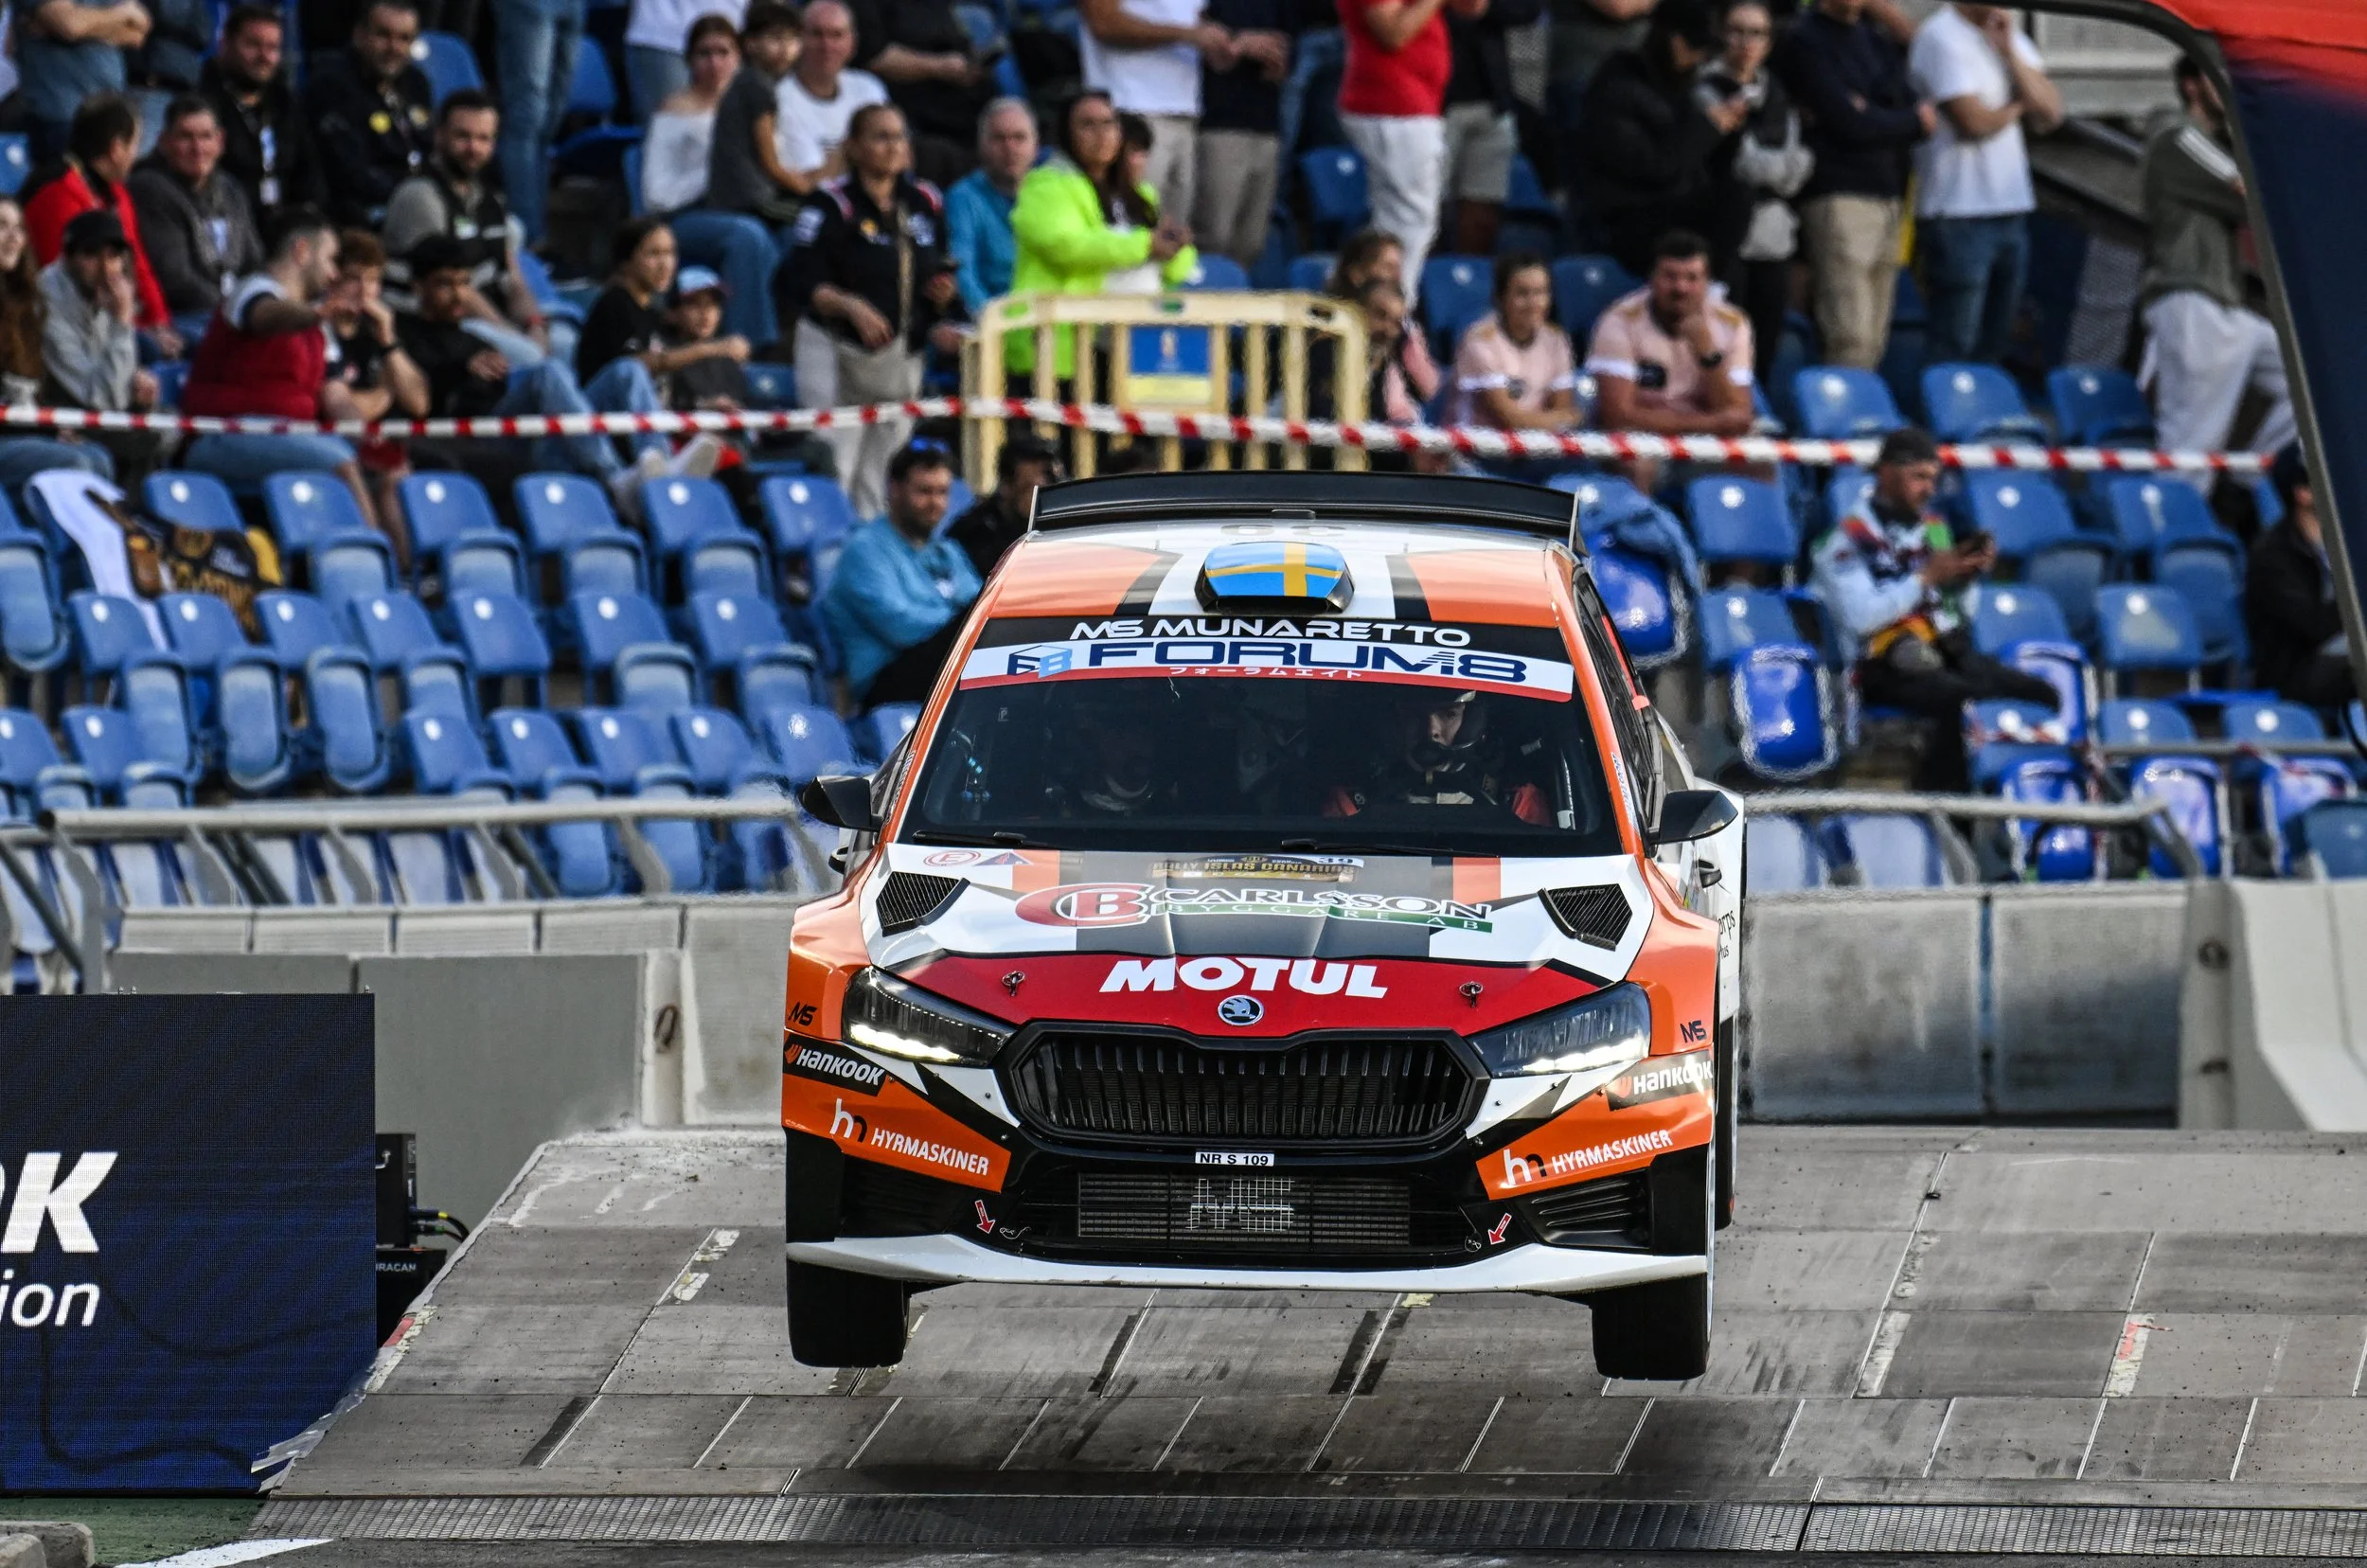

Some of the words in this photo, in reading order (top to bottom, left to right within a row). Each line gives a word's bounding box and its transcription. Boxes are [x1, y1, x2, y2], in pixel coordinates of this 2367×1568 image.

[1070, 620, 1144, 640] MS
[1150, 618, 1470, 647] MUNARETTO
[1089, 641, 1526, 683] FORUM8
[1169, 667, 1361, 679] フォーラムエイト
[1204, 863, 1255, 871] ISLAS
[1261, 863, 1354, 874] CANARIAS
[1149, 888, 1492, 920] CARLSSON
[1167, 903, 1371, 920] BYGGARE
[1427, 917, 1479, 930] AB
[1099, 957, 1388, 999] MOTUL
[788, 1002, 817, 1025] MS
[1680, 1020, 1707, 1043] MS
[870, 1127, 989, 1176] HYRMASKINER
[1200, 1153, 1221, 1164] NR
[1227, 1154, 1237, 1165] S
[1243, 1155, 1269, 1166] 109
[1551, 1130, 1674, 1175] HYRMASKINER
[0, 1151, 118, 1254] K
